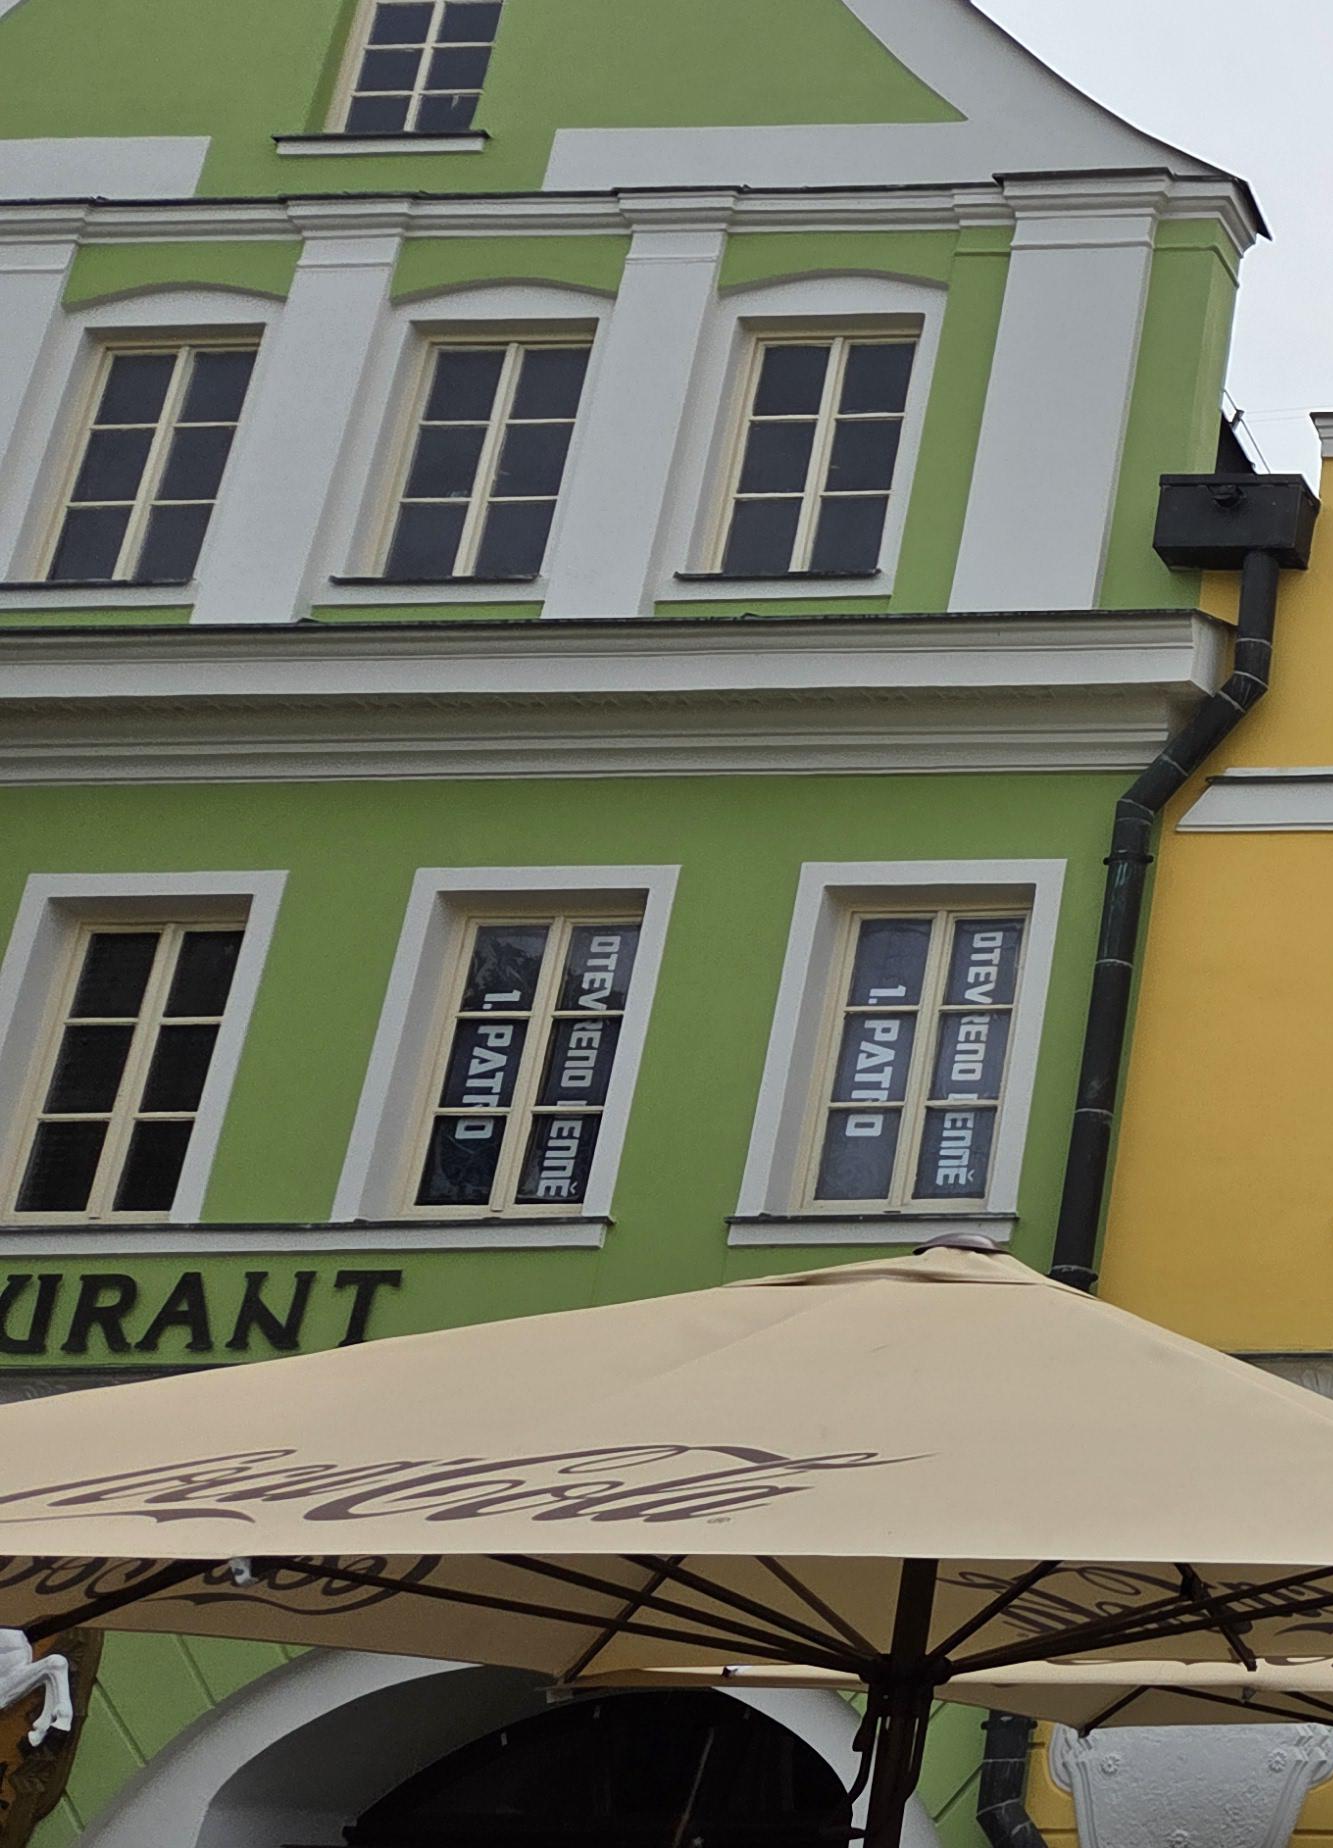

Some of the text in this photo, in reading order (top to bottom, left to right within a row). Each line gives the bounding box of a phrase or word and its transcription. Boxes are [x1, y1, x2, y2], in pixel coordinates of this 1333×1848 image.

[482, 989, 522, 1010] 1.
[868, 984, 906, 1004] 1.
[0, 1269, 403, 1353] URANT
